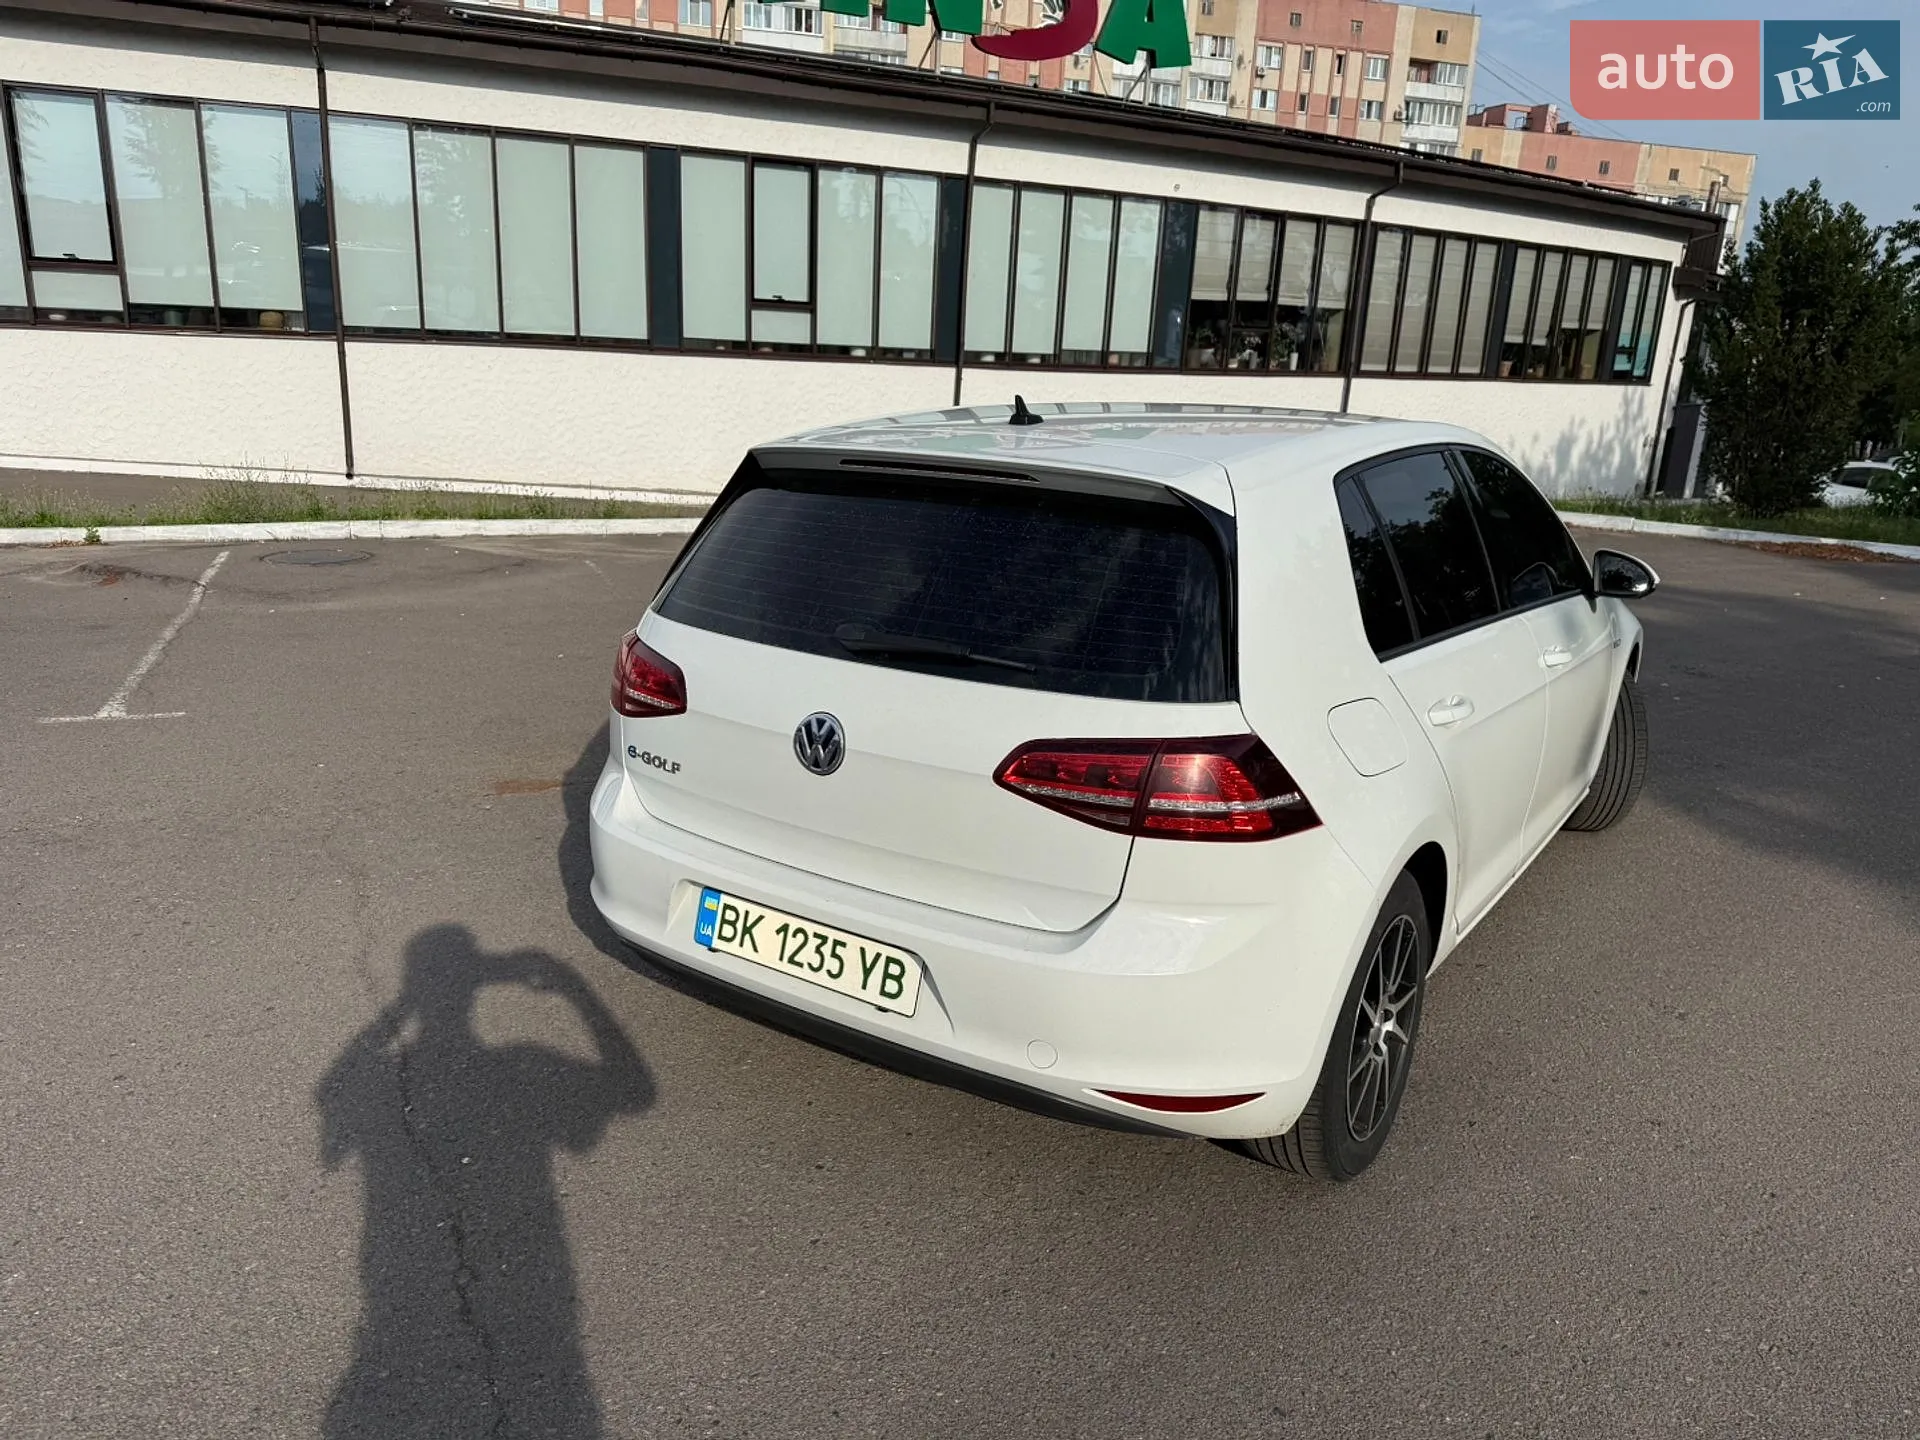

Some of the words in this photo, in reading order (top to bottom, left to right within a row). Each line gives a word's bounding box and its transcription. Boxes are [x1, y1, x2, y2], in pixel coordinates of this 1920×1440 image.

[700, 921, 713, 937] UA
[717, 902, 765, 953] BK
[775, 922, 847, 980] 1235
[859, 946, 906, 1000] YB
